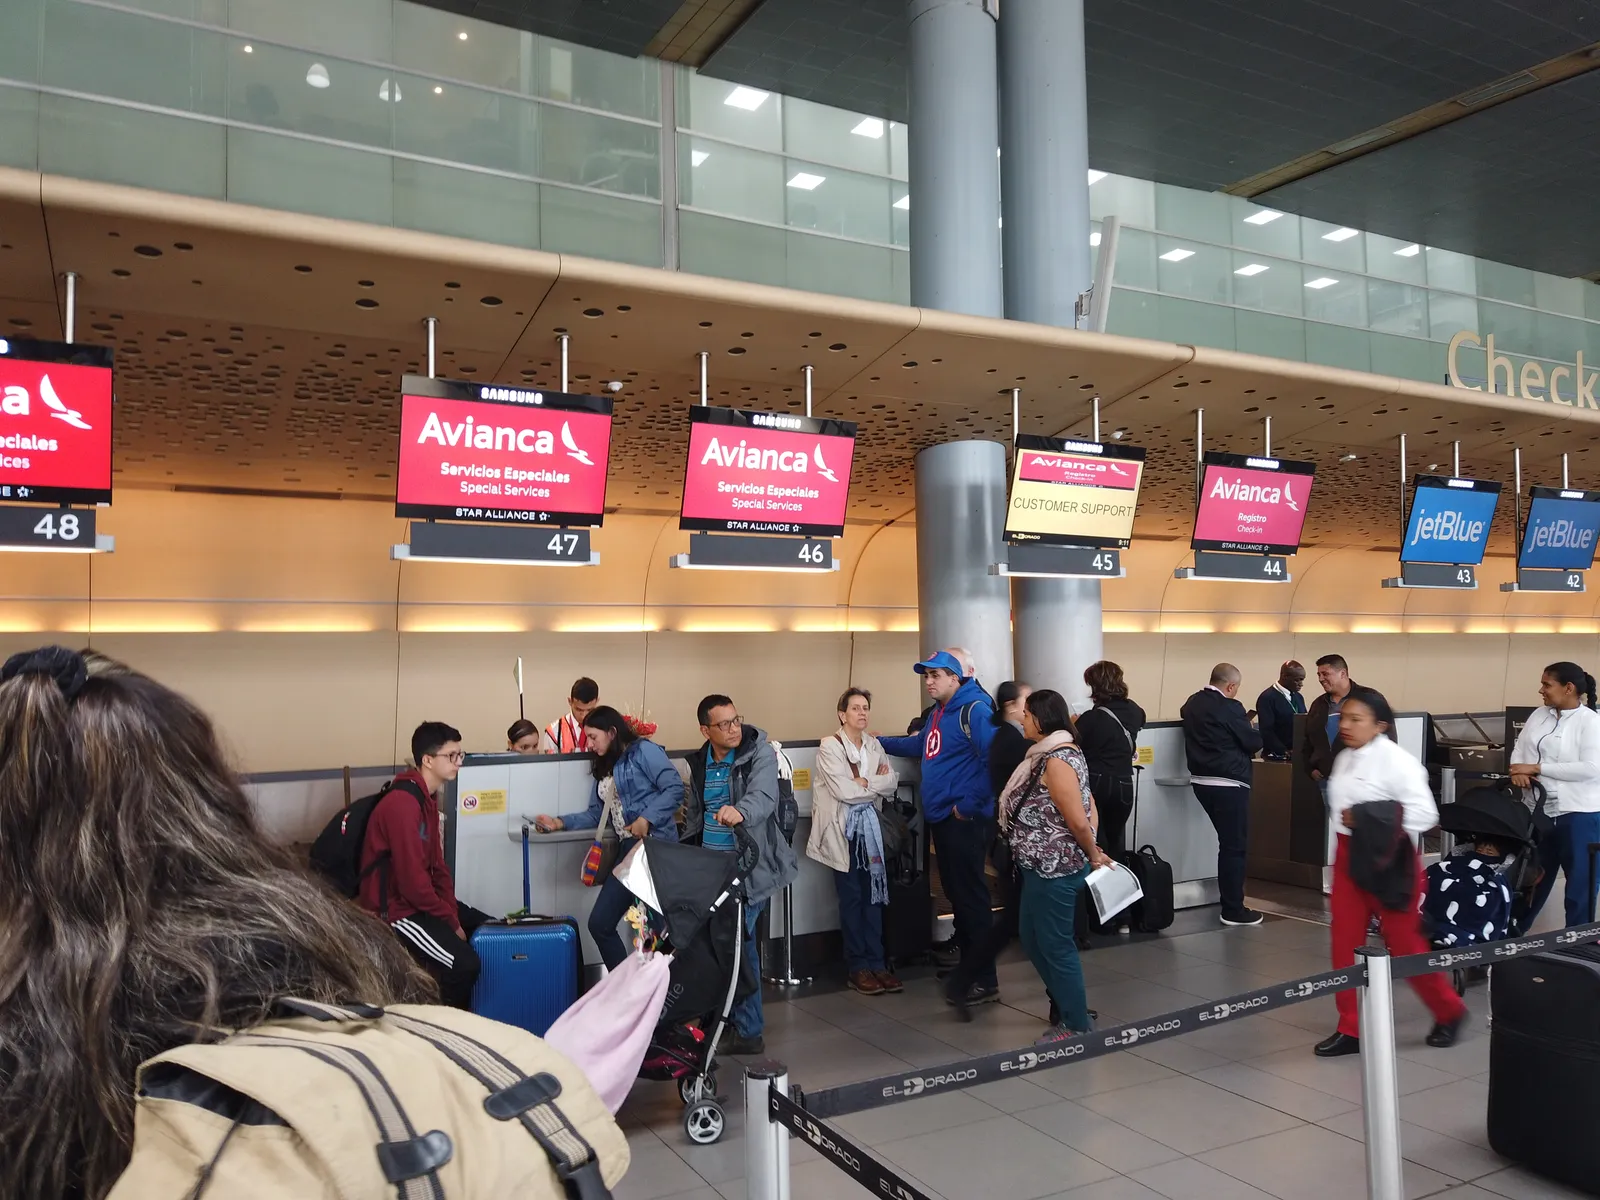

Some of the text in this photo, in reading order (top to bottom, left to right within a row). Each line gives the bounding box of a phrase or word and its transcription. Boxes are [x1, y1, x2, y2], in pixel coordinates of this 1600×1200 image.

[1447, 330, 1600, 410] Check
[481, 387, 543, 404] SAMSUNG
[752, 415, 802, 429] SAMSUNG
[417, 412, 554, 455] Avianca
[701, 437, 808, 473] Avianca
[1030, 456, 1107, 472] Avianca
[440, 462, 570, 484] Servicios Especiales
[460, 480, 550, 498] Special Services
[717, 480, 819, 499] Servicios Especiales
[1210, 476, 1281, 504] Avianca
[731, 497, 803, 512] Special Services
[1013, 496, 1134, 517] CUSTOMER SUPPORT
[455, 507, 536, 521] STAR ALLIANCE
[1237, 512, 1267, 524] Registro
[33, 513, 80, 541] 48
[726, 521, 790, 532] STAR ALLIANCE
[1237, 525, 1263, 534] Check-in
[1411, 508, 1484, 546] jetBlue
[1528, 518, 1593, 553] jetBlue
[547, 533, 579, 556] 47
[798, 543, 824, 564] 46
[1236, 543, 1263, 551] ALLIANCE
[1092, 553, 1114, 571] 45
[1263, 560, 1282, 576] 44
[1456, 569, 1471, 584] 43
[1567, 574, 1581, 588] 42
